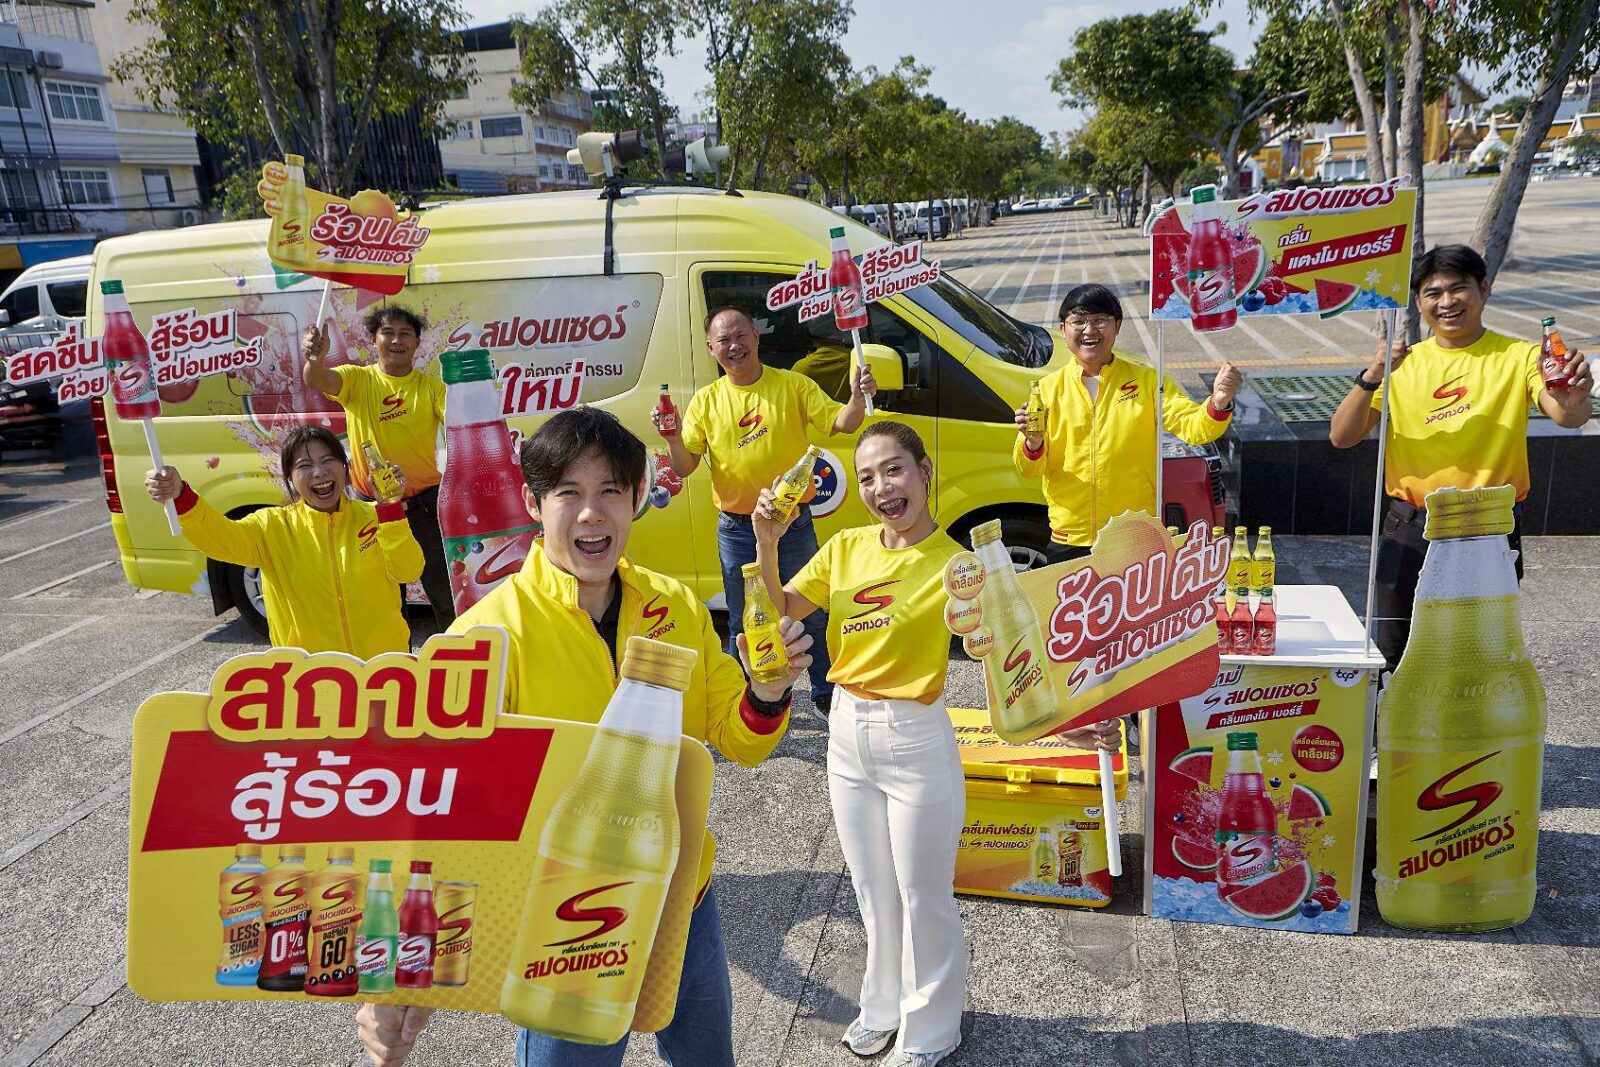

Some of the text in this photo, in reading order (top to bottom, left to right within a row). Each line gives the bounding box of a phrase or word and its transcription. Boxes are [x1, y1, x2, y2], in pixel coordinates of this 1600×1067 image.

[1265, 178, 1400, 213] สปอนเซอร์
[311, 203, 430, 247] ร้อน ดื่ม
[1278, 224, 1311, 248] กลิ่น
[334, 246, 413, 263] สปอนเซอร์
[862, 244, 919, 285] สู้ร้อน
[1287, 228, 1394, 270] แตงโม เบอร์รี่
[769, 262, 827, 307] สดชื่น
[866, 262, 939, 301] สปอนเซอร์
[479, 305, 628, 348] สปอนเซอร์
[800, 299, 830, 320] ด้วย
[10, 325, 99, 381] สดชื่น
[150, 313, 230, 362] สู้ร้อน
[157, 339, 260, 384] สปอนเซอร์
[61, 376, 104, 400] ด้วย
[502, 361, 585, 415] ใหม่
[1424, 404, 1473, 426] SPONSOR
[737, 427, 769, 449] SPONSOR
[1047, 519, 1232, 661] ร้อน ดื่ม
[842, 616, 893, 636] SPONSOR
[1094, 587, 1220, 676] สปอนเซอร์
[219, 639, 493, 731] สถานี
[1224, 677, 1320, 706] สปอนเซอร์
[1335, 668, 1356, 682] tcp
[1297, 747, 1337, 760] เกลือแร่
[230, 749, 459, 841] สู้ร้อน
[1398, 815, 1516, 879] สปอนเซอร์
[229, 922, 261, 944] LESS
[229, 938, 259, 956] SUGAR
[320, 936, 347, 969] GO
[523, 943, 629, 980] สปอนเซอร์
